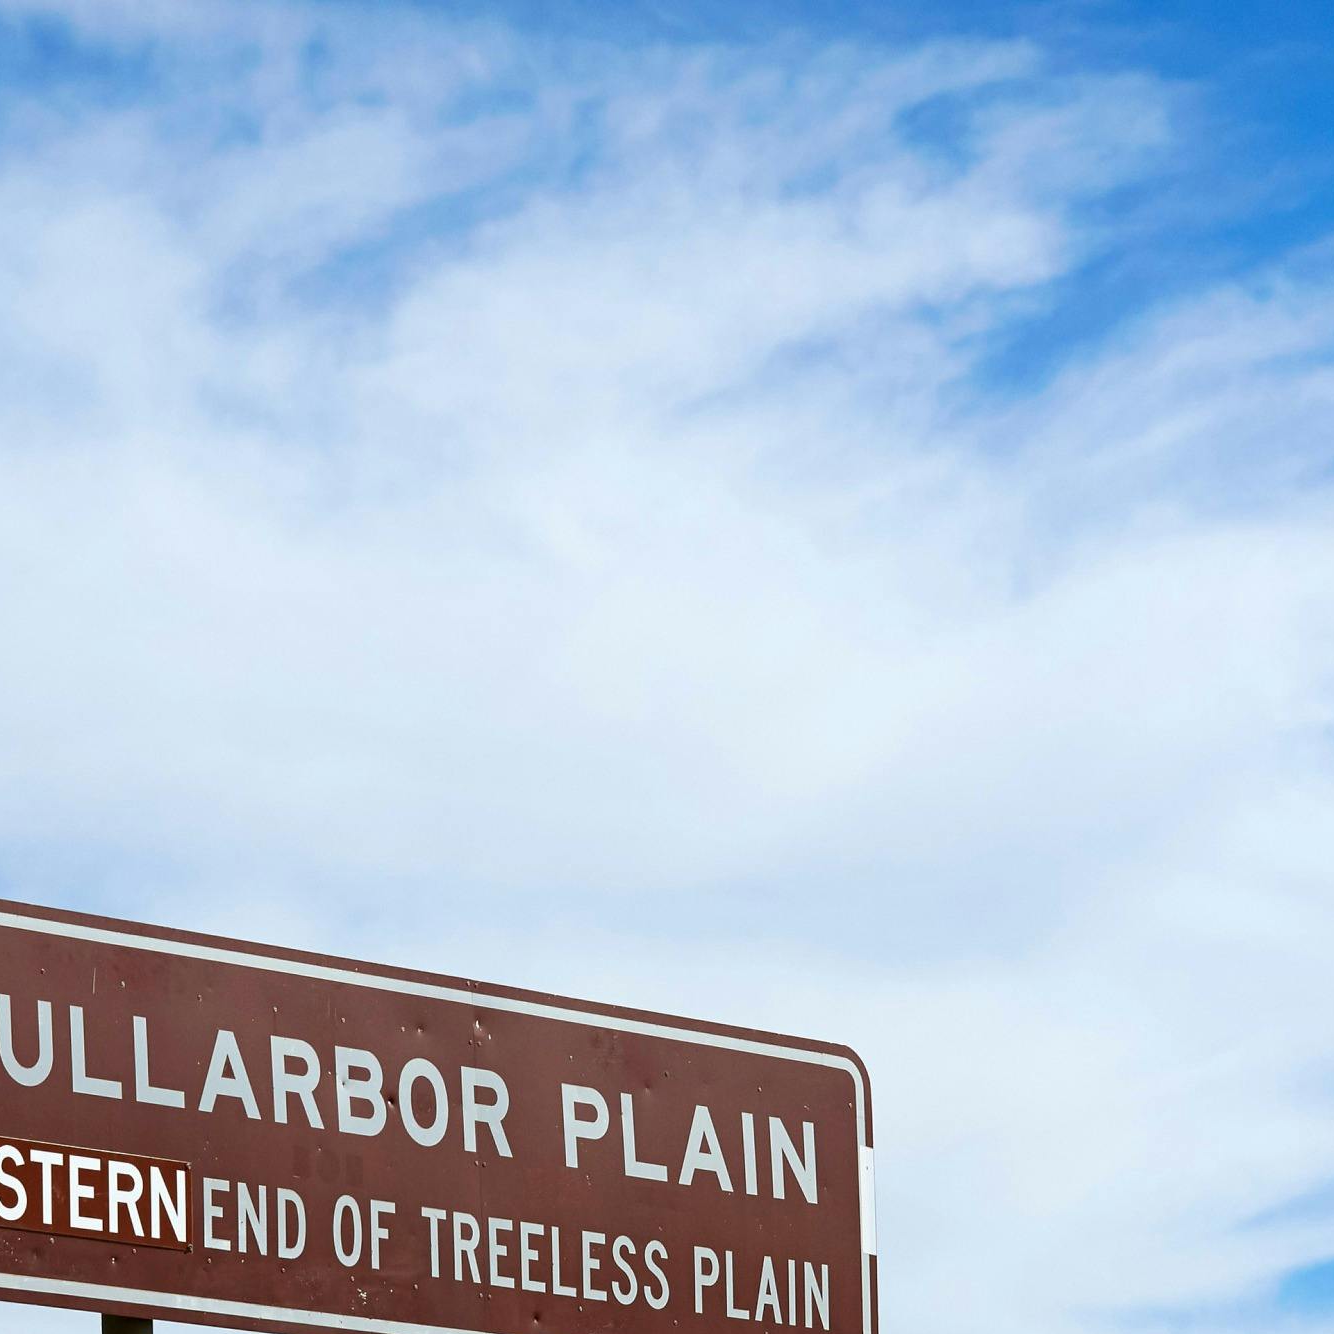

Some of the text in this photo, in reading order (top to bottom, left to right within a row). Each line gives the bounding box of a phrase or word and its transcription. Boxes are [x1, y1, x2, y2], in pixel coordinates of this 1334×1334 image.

[561, 1082, 818, 1205] PLAIN
[203, 1177, 307, 1260] END
[332, 1194, 396, 1270] OF
[421, 1206, 670, 1310] TREELESS
[693, 1245, 830, 1331] PLAIN
